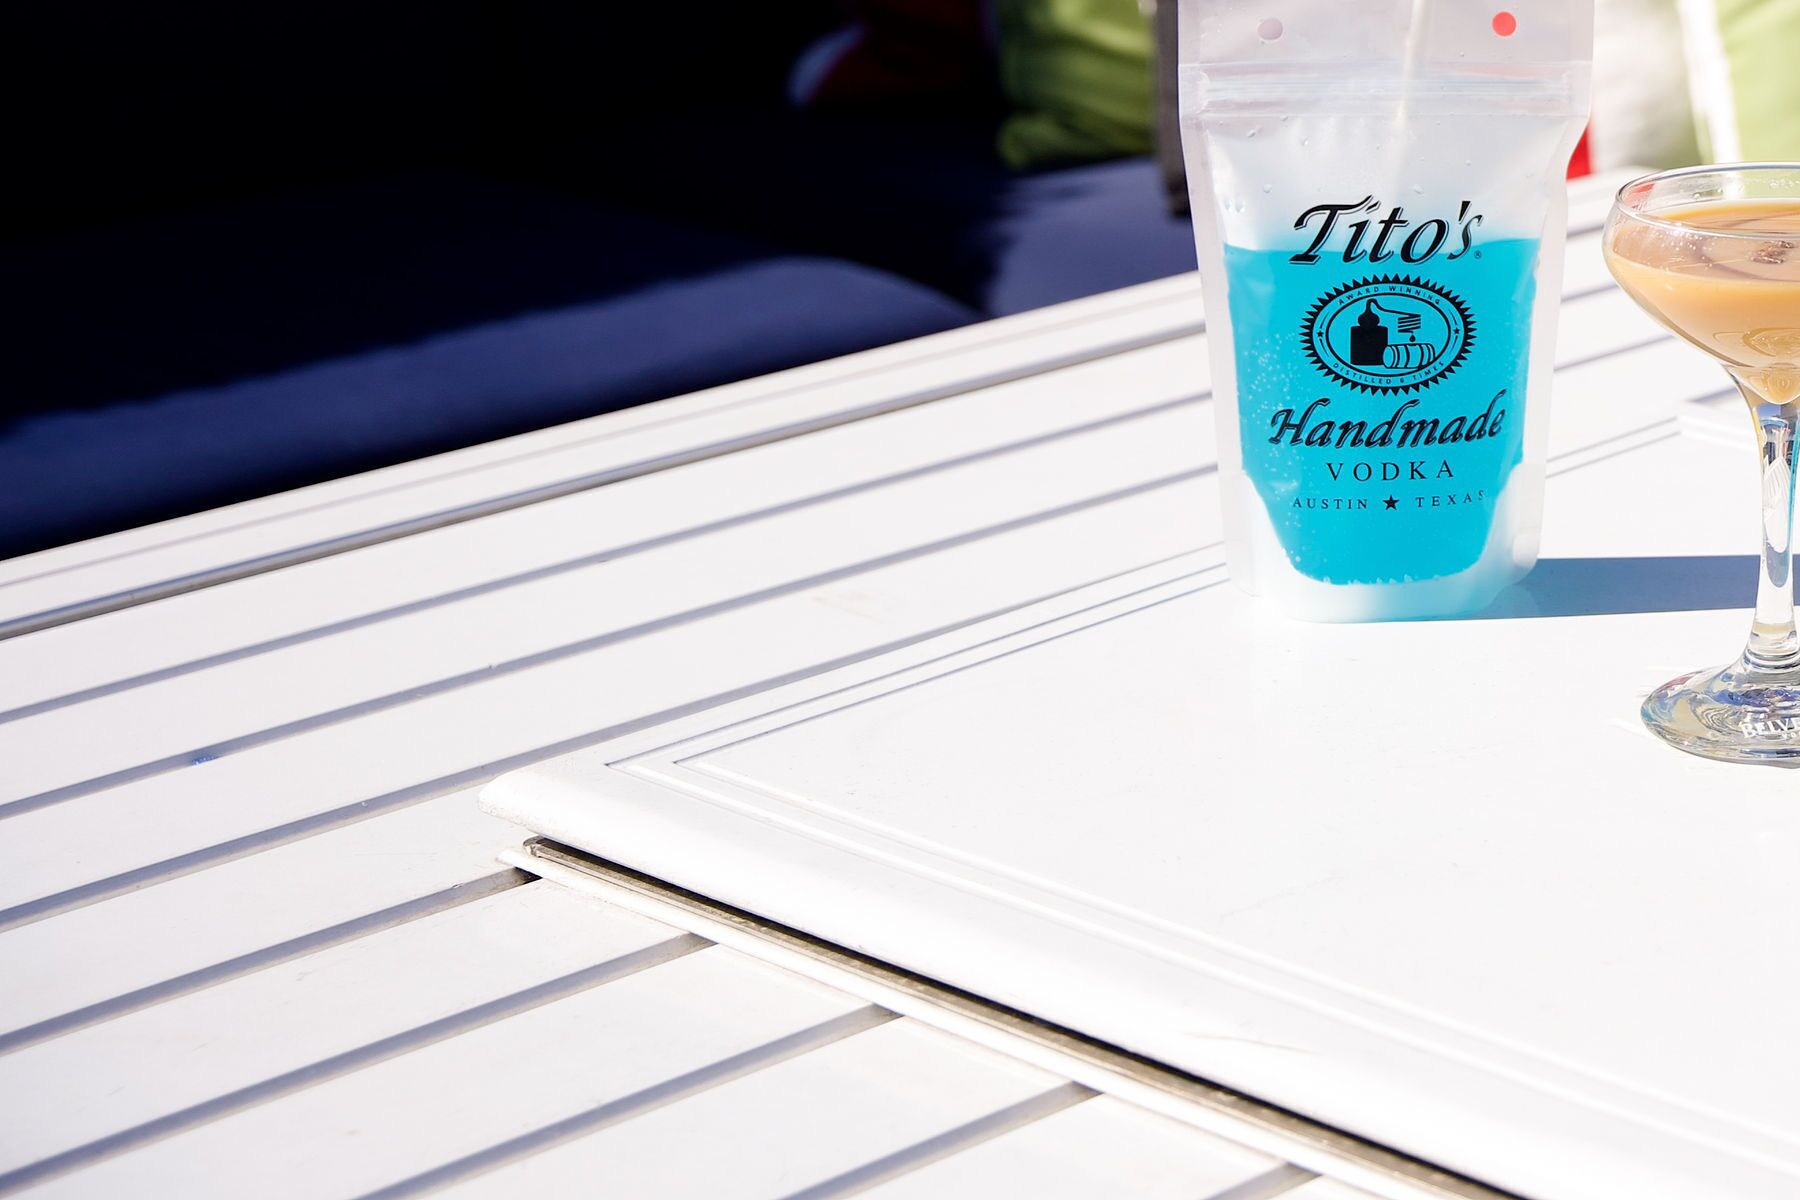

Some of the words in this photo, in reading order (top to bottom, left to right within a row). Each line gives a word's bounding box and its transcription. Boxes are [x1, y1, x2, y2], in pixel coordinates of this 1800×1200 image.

[1338, 285, 1380, 306] AWARD
[1388, 285, 1441, 306] WINNING
[1332, 361, 1393, 386] DISTILLED
[1411, 361, 1445, 382] TIMES
[1268, 389, 1507, 449] Handmade
[1326, 459, 1454, 482] VODKA
[1292, 496, 1368, 510] AUSTIN
[1415, 489, 1485, 508] TEXAS
